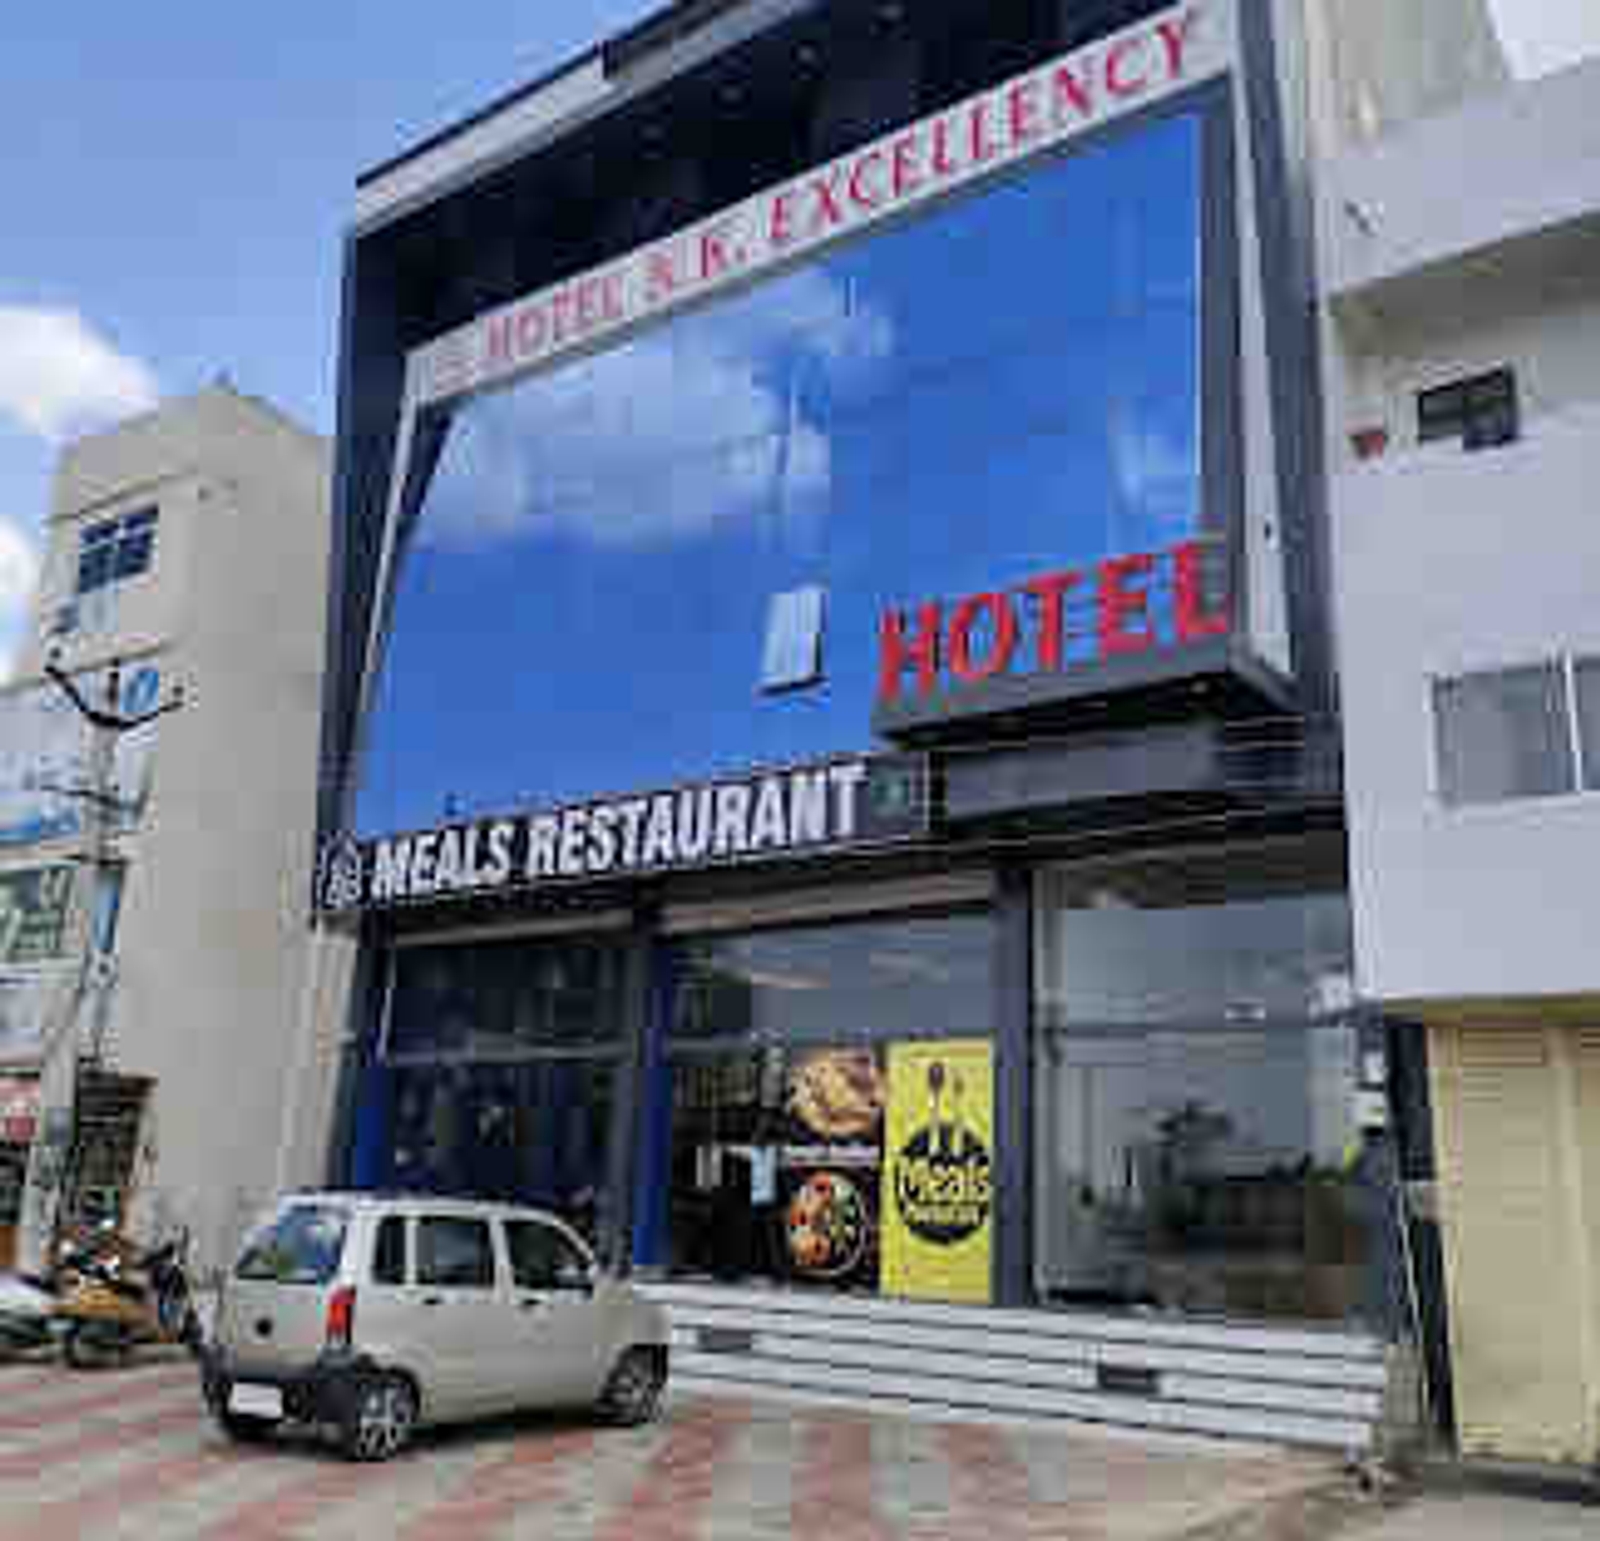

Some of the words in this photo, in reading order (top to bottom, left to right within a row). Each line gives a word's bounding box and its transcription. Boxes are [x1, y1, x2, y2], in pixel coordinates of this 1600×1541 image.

[482, 273, 624, 362] HOTEL
[767, 17, 1190, 240] EXCELLENCY
[878, 541, 1229, 705] HOTEL
[370, 822, 512, 898] MEALS
[523, 763, 868, 878] RESTAURANT
